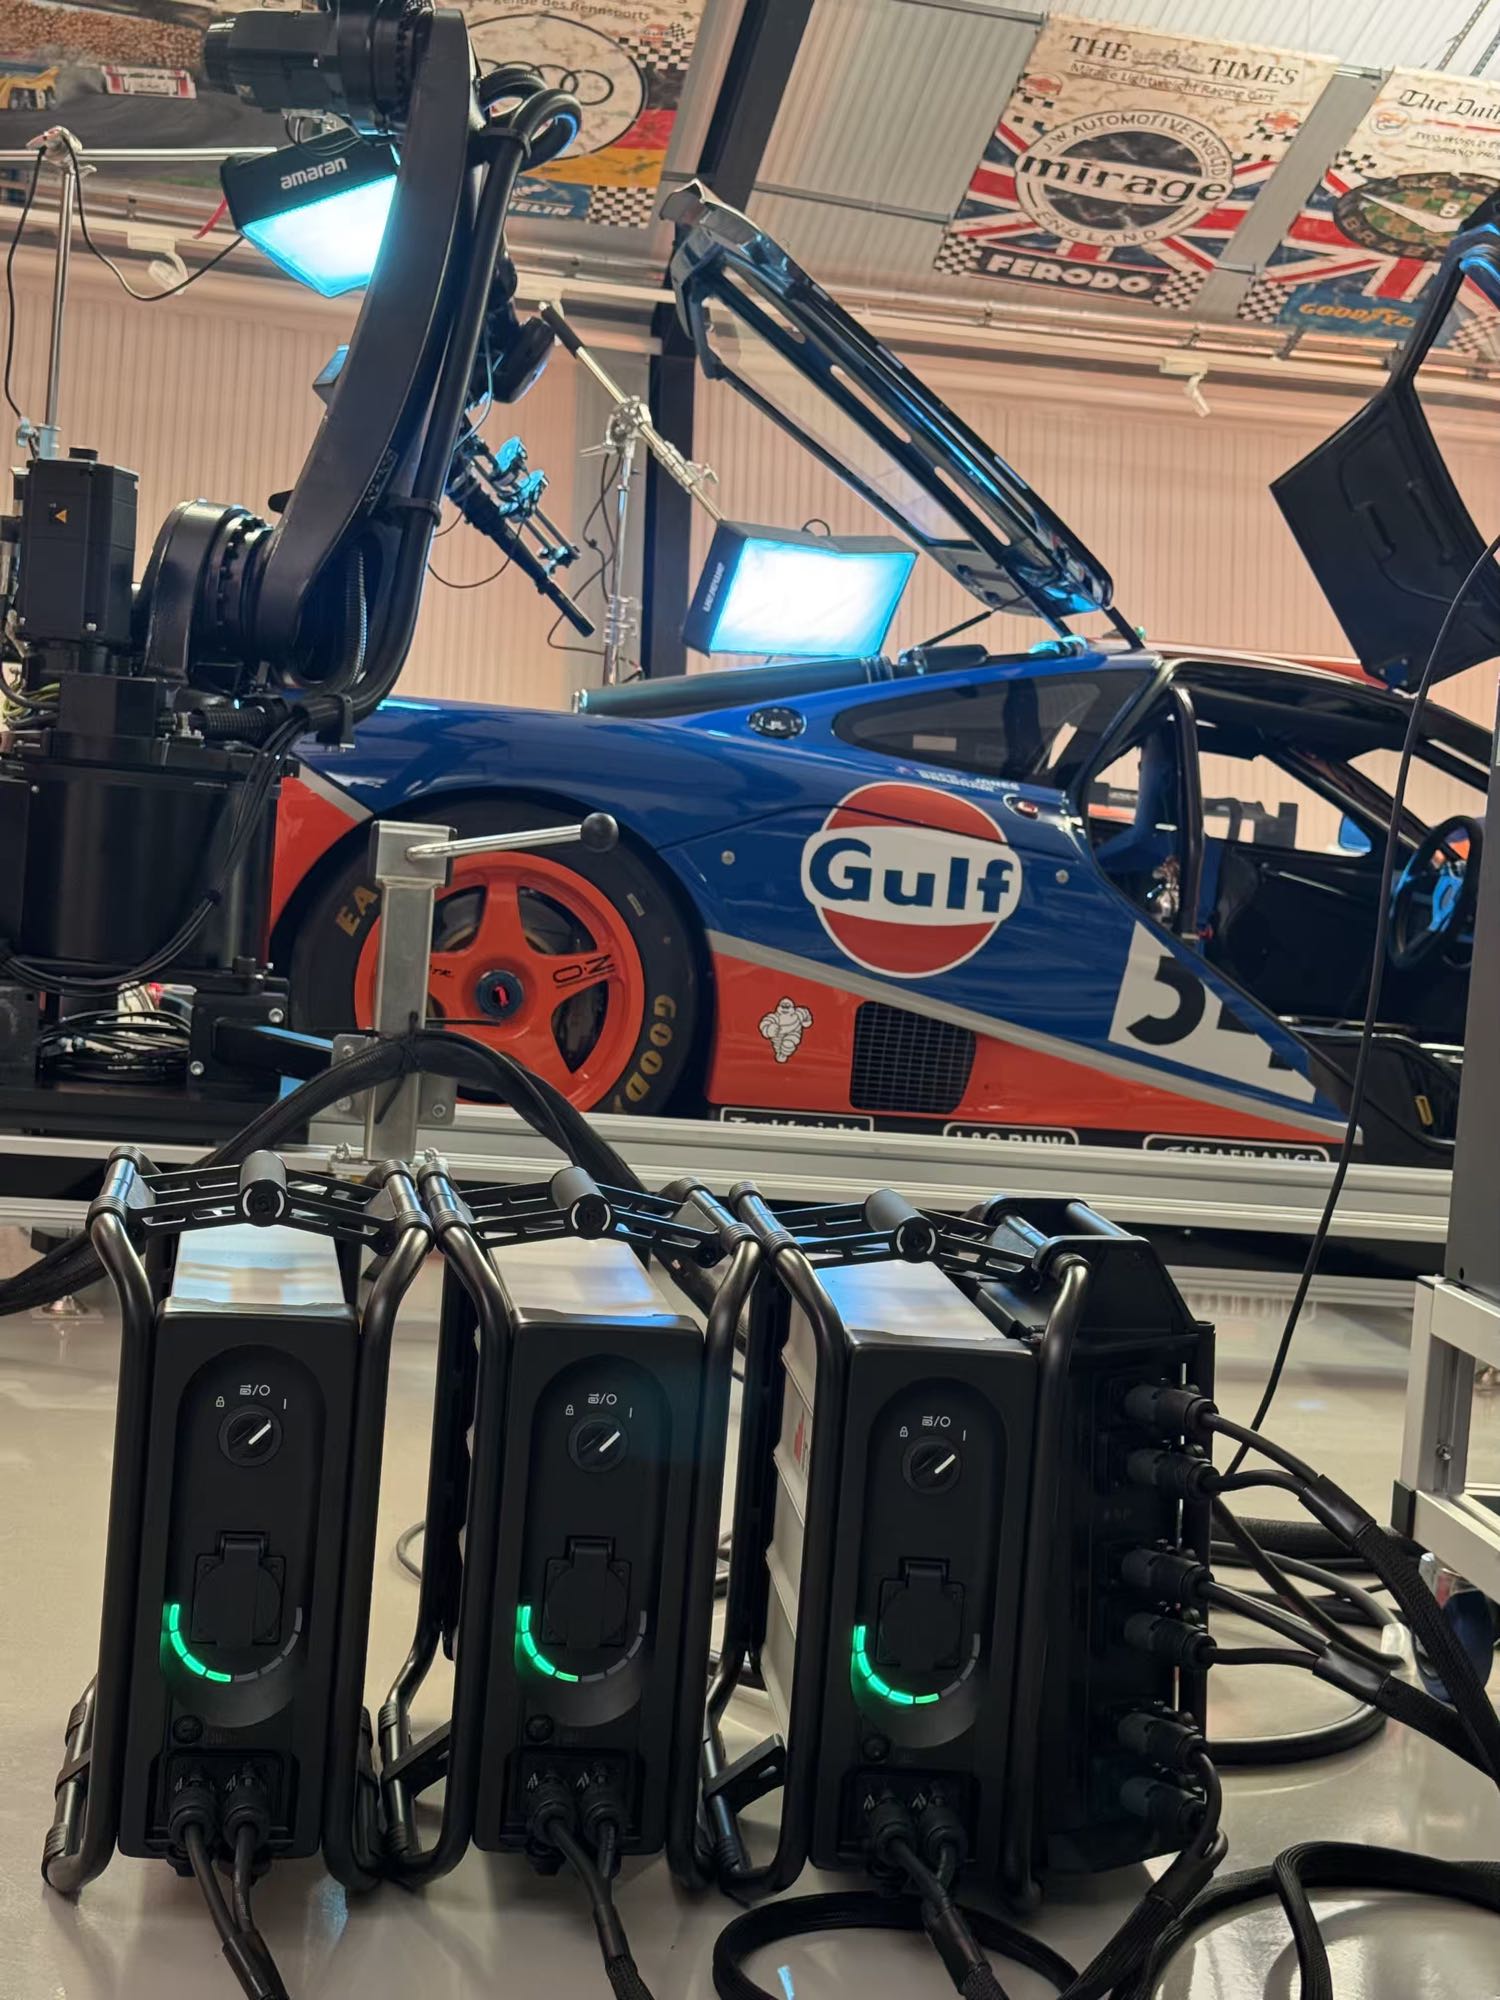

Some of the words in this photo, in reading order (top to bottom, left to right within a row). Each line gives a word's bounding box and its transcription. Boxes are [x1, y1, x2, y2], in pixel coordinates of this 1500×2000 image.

[1069, 35, 1132, 62] THE
[1208, 56, 1299, 86] TIMES
[1398, 89, 1448, 111] The
[1072, 114, 1191, 135] AUTOMOTIVE
[280, 157, 347, 190] amaran
[1020, 155, 1226, 204] mirage
[1036, 210, 1157, 242] ENGLAND
[987, 253, 1151, 293] FERODO
[809, 837, 1013, 913] Gulf
